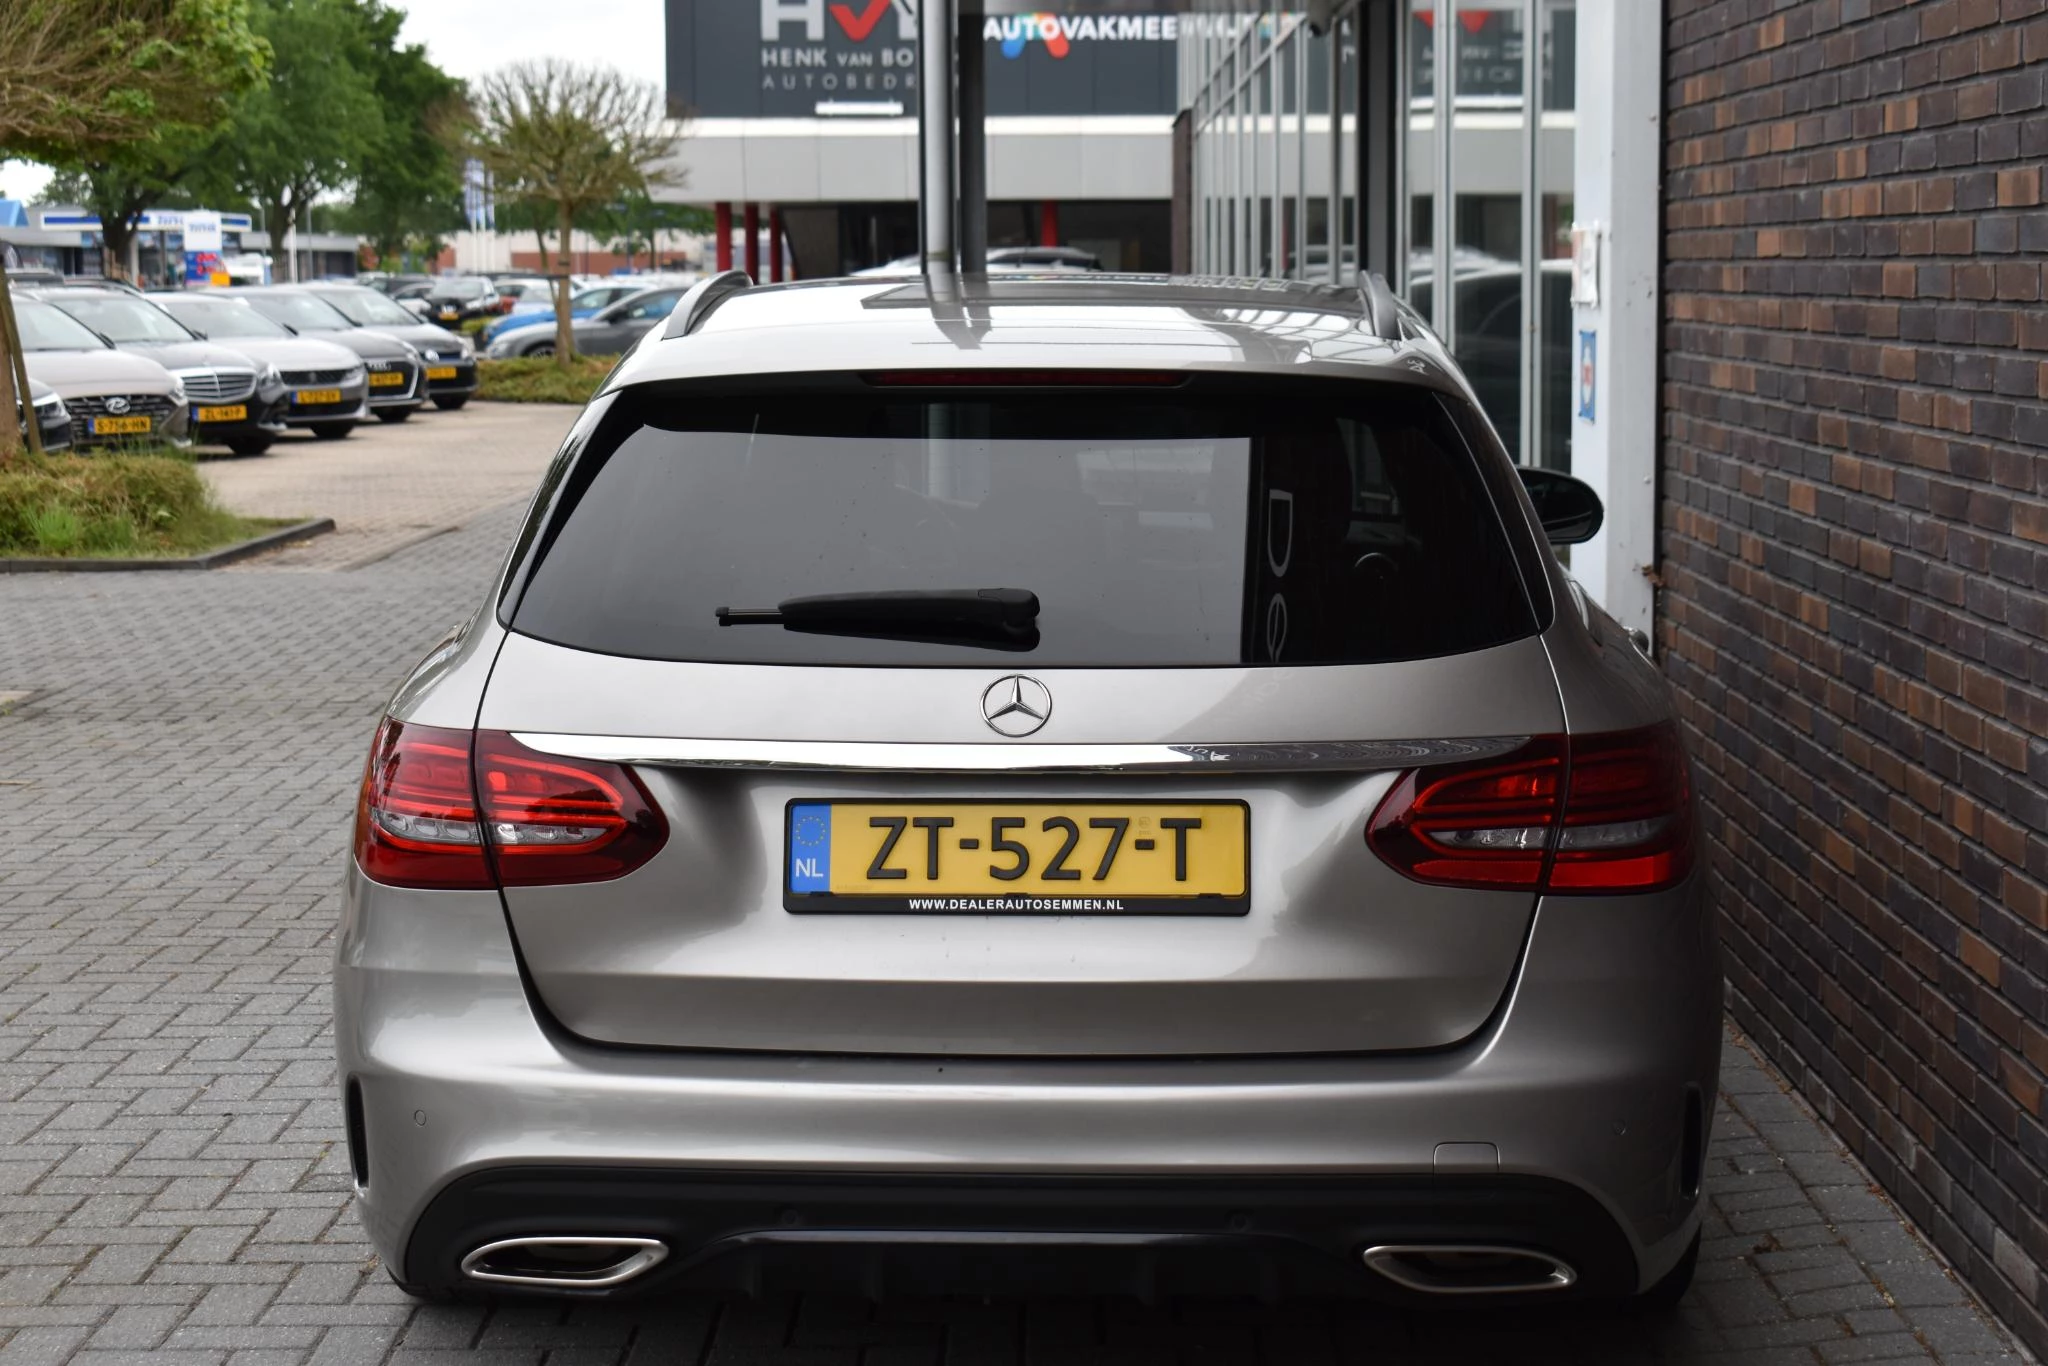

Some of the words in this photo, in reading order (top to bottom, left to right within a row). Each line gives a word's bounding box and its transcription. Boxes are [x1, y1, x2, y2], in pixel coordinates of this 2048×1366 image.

[983, 16, 1177, 41] AUTOVAKMEE
[761, 48, 827, 67] HENK
[837, 53, 873, 67] VAN
[881, 48, 915, 67] BO
[762, 73, 917, 91] AUTOBEDR
[795, 858, 824, 878] NL
[866, 816, 1202, 882] ZT-527-T
[909, 899, 1124, 911] WWW.DEALERAUTOSEMMEN.NL
